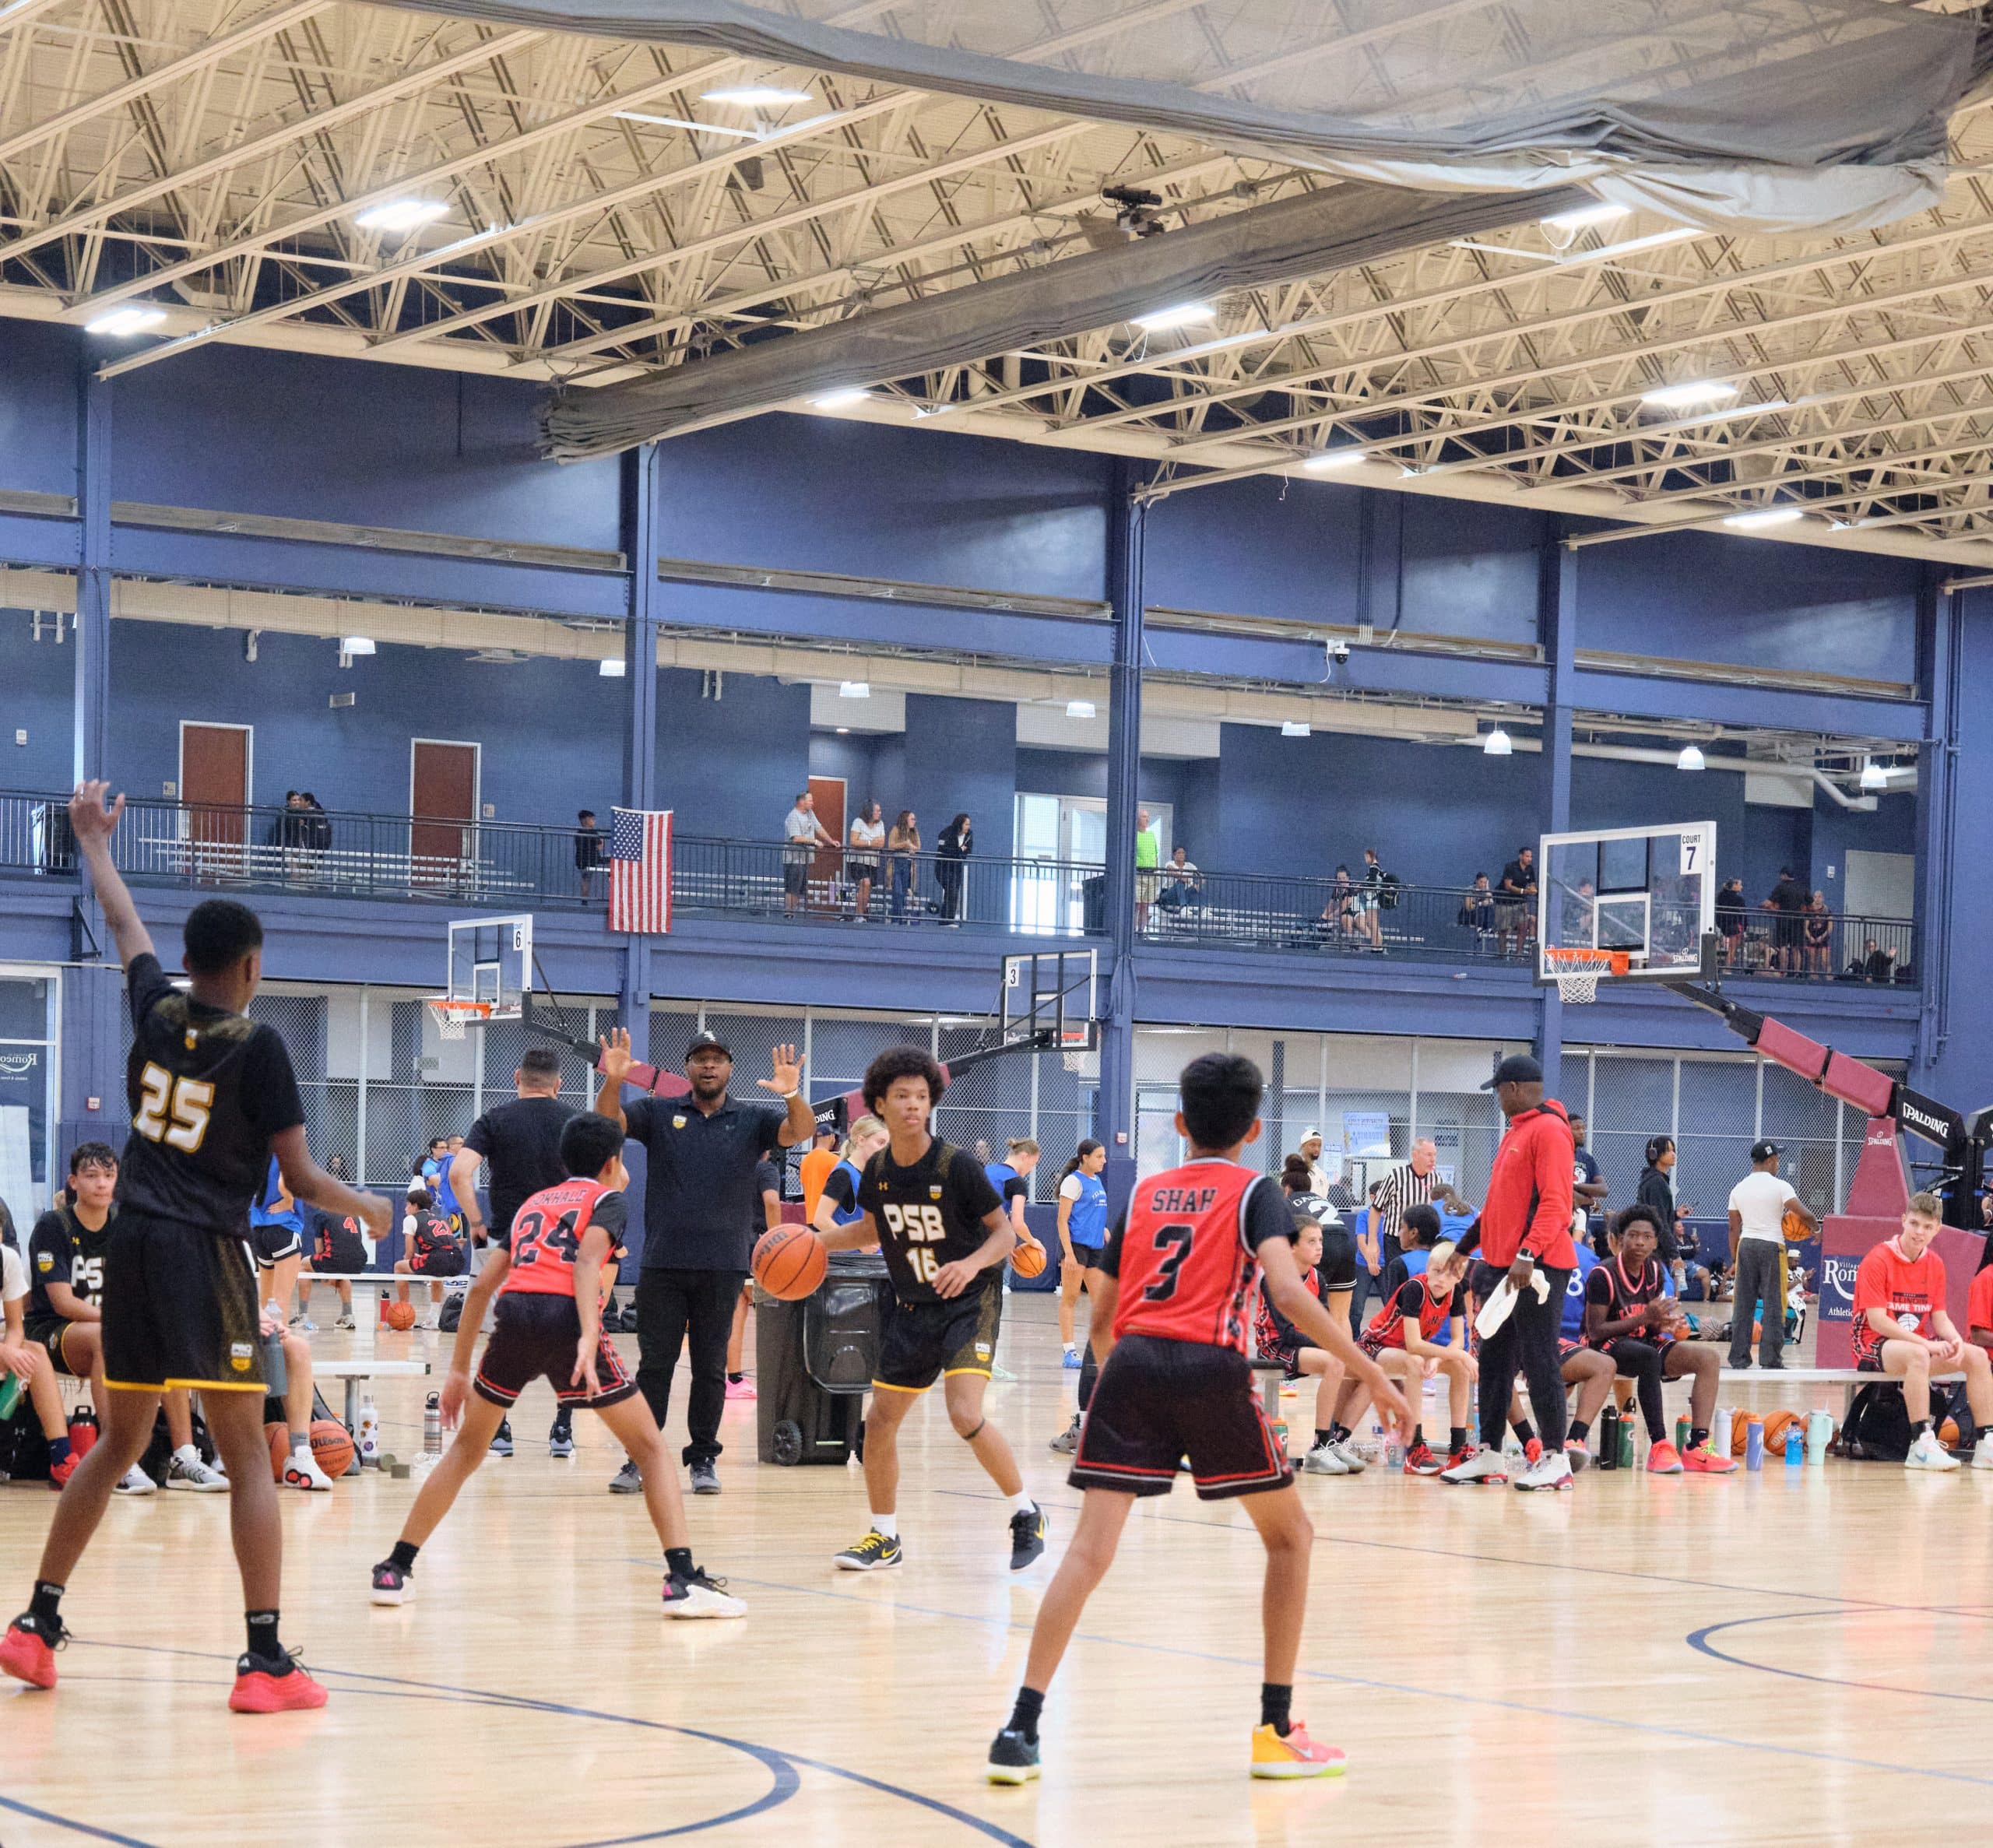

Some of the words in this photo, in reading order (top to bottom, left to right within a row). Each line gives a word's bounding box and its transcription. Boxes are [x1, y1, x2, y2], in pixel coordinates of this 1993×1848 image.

[1682, 834, 1701, 845] COURT
[1686, 846, 1696, 870] 7
[515, 930, 521, 948] 6
[1010, 968, 1016, 985] 3
[132, 1059, 216, 1154] 25
[1903, 1101, 1949, 1139] SPALDING
[1868, 1136, 1893, 1147] SPALDING
[1151, 1188, 1218, 1213] SHAH
[1308, 1199, 1345, 1225] 2
[343, 1216, 358, 1234] 4
[427, 1219, 453, 1238] 21
[882, 1203, 947, 1242] PSB
[512, 1209, 581, 1269] 24
[905, 1246, 940, 1284] 16
[1144, 1224, 1195, 1302] 3
[1893, 1295, 1928, 1305] LLINOIS
[1913, 1304, 1932, 1312] TIM
